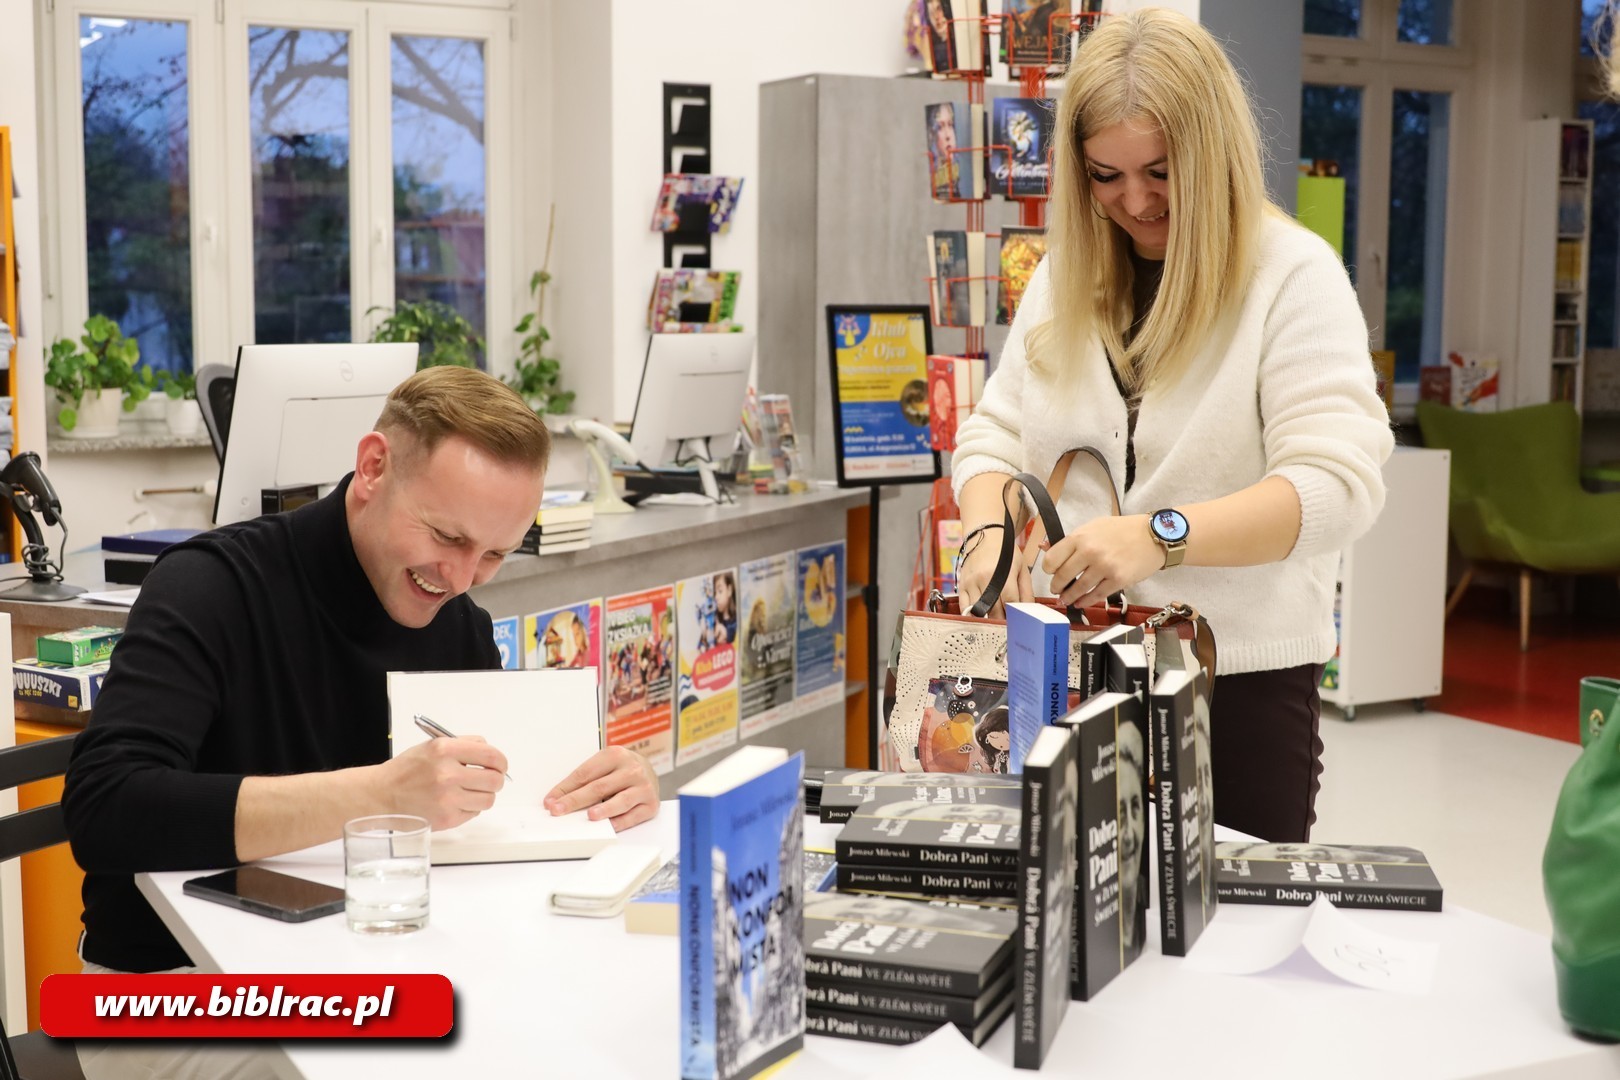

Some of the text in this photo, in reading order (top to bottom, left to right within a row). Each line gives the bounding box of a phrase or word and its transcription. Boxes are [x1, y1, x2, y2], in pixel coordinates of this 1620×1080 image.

[712, 649, 734, 669] LEGO
[1160, 781, 1173, 820] Dobra
[1162, 822, 1175, 852] Pani
[875, 848, 910, 859] Milewski
[920, 850, 958, 864] Dobra
[961, 851, 989, 865] Pani
[1089, 842, 1118, 890] Pani
[922, 875, 960, 889] Dobra
[963, 876, 991, 890] Pani
[1234, 887, 1267, 897] Milewski
[1276, 888, 1312, 901] Dobra
[1344, 892, 1355, 902] W
[1356, 893, 1383, 904] ZŁYM
[1386, 892, 1427, 905] ŚWIECIE
[805, 958, 829, 973] brá
